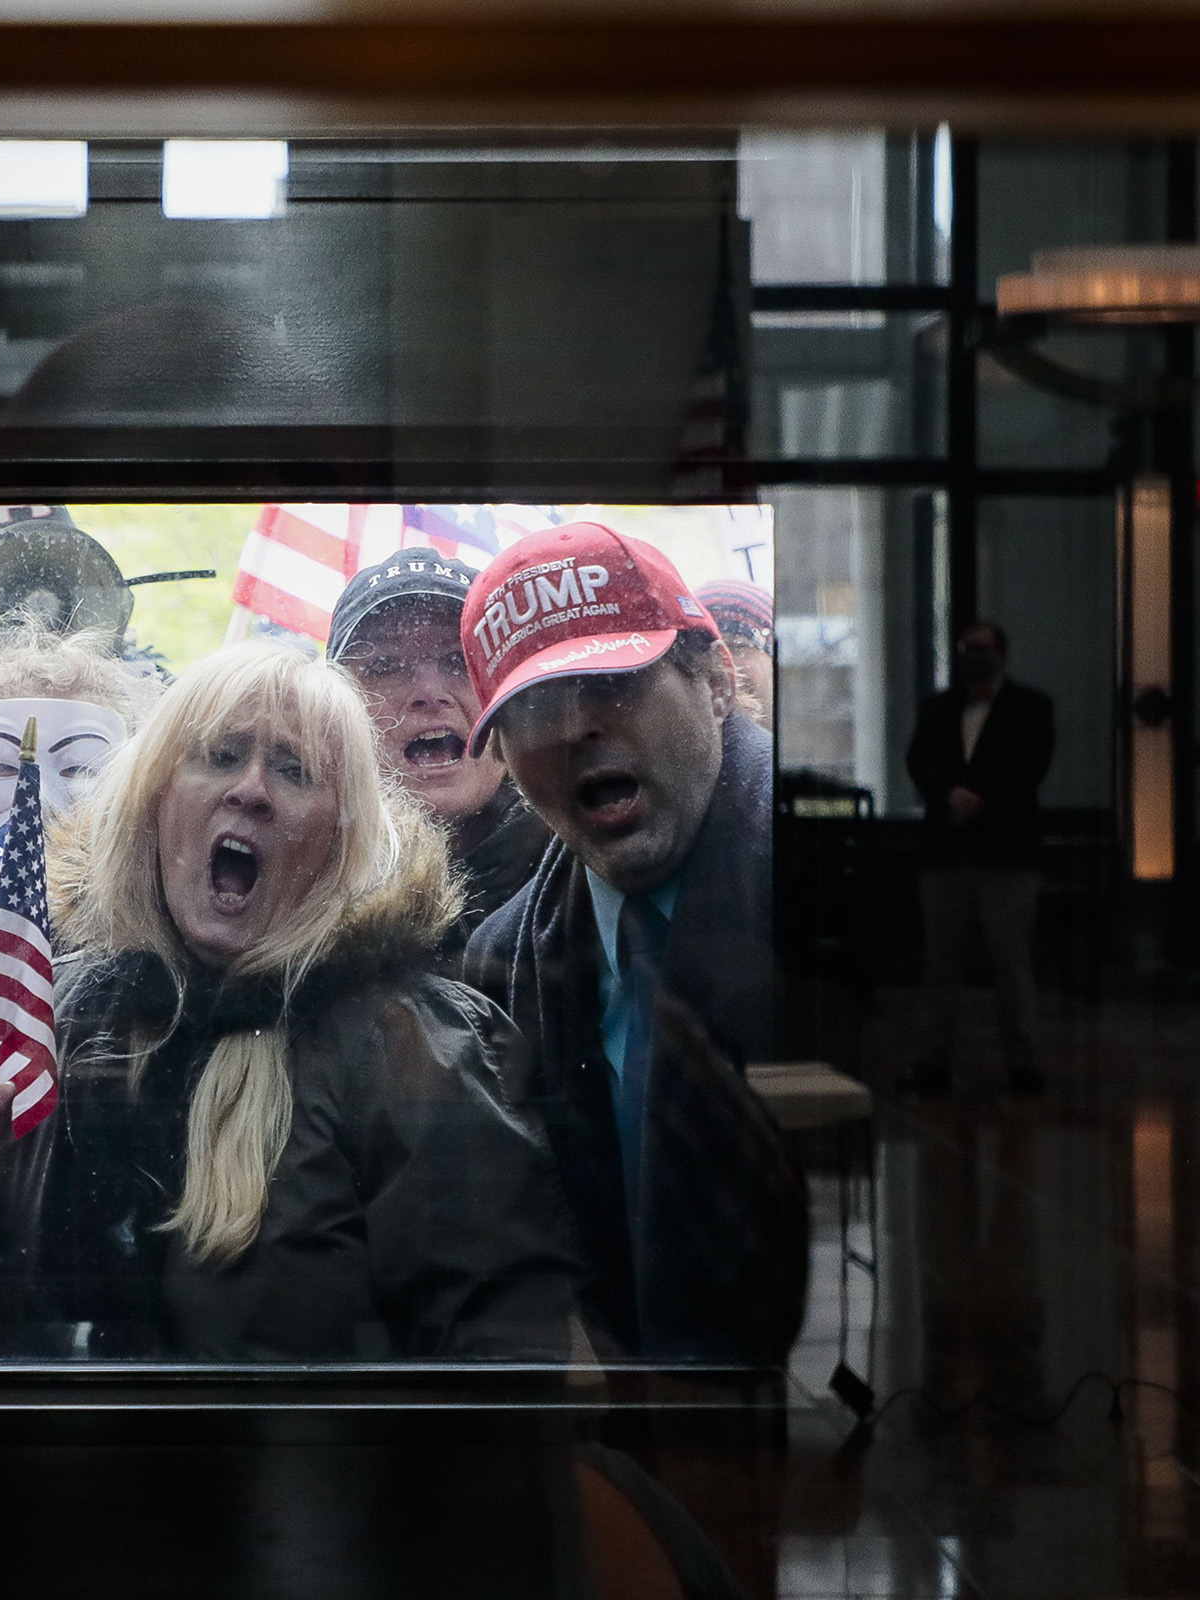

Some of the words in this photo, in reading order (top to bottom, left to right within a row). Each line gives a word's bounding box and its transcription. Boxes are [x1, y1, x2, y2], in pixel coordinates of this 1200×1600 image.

[368, 562, 471, 588] TRUMP
[506, 556, 576, 589] PRESIDENT
[473, 565, 610, 660] TRUMP
[502, 621, 543, 656] AMERICA
[541, 607, 581, 628] GREAT
[582, 603, 620, 618] AGAIN
